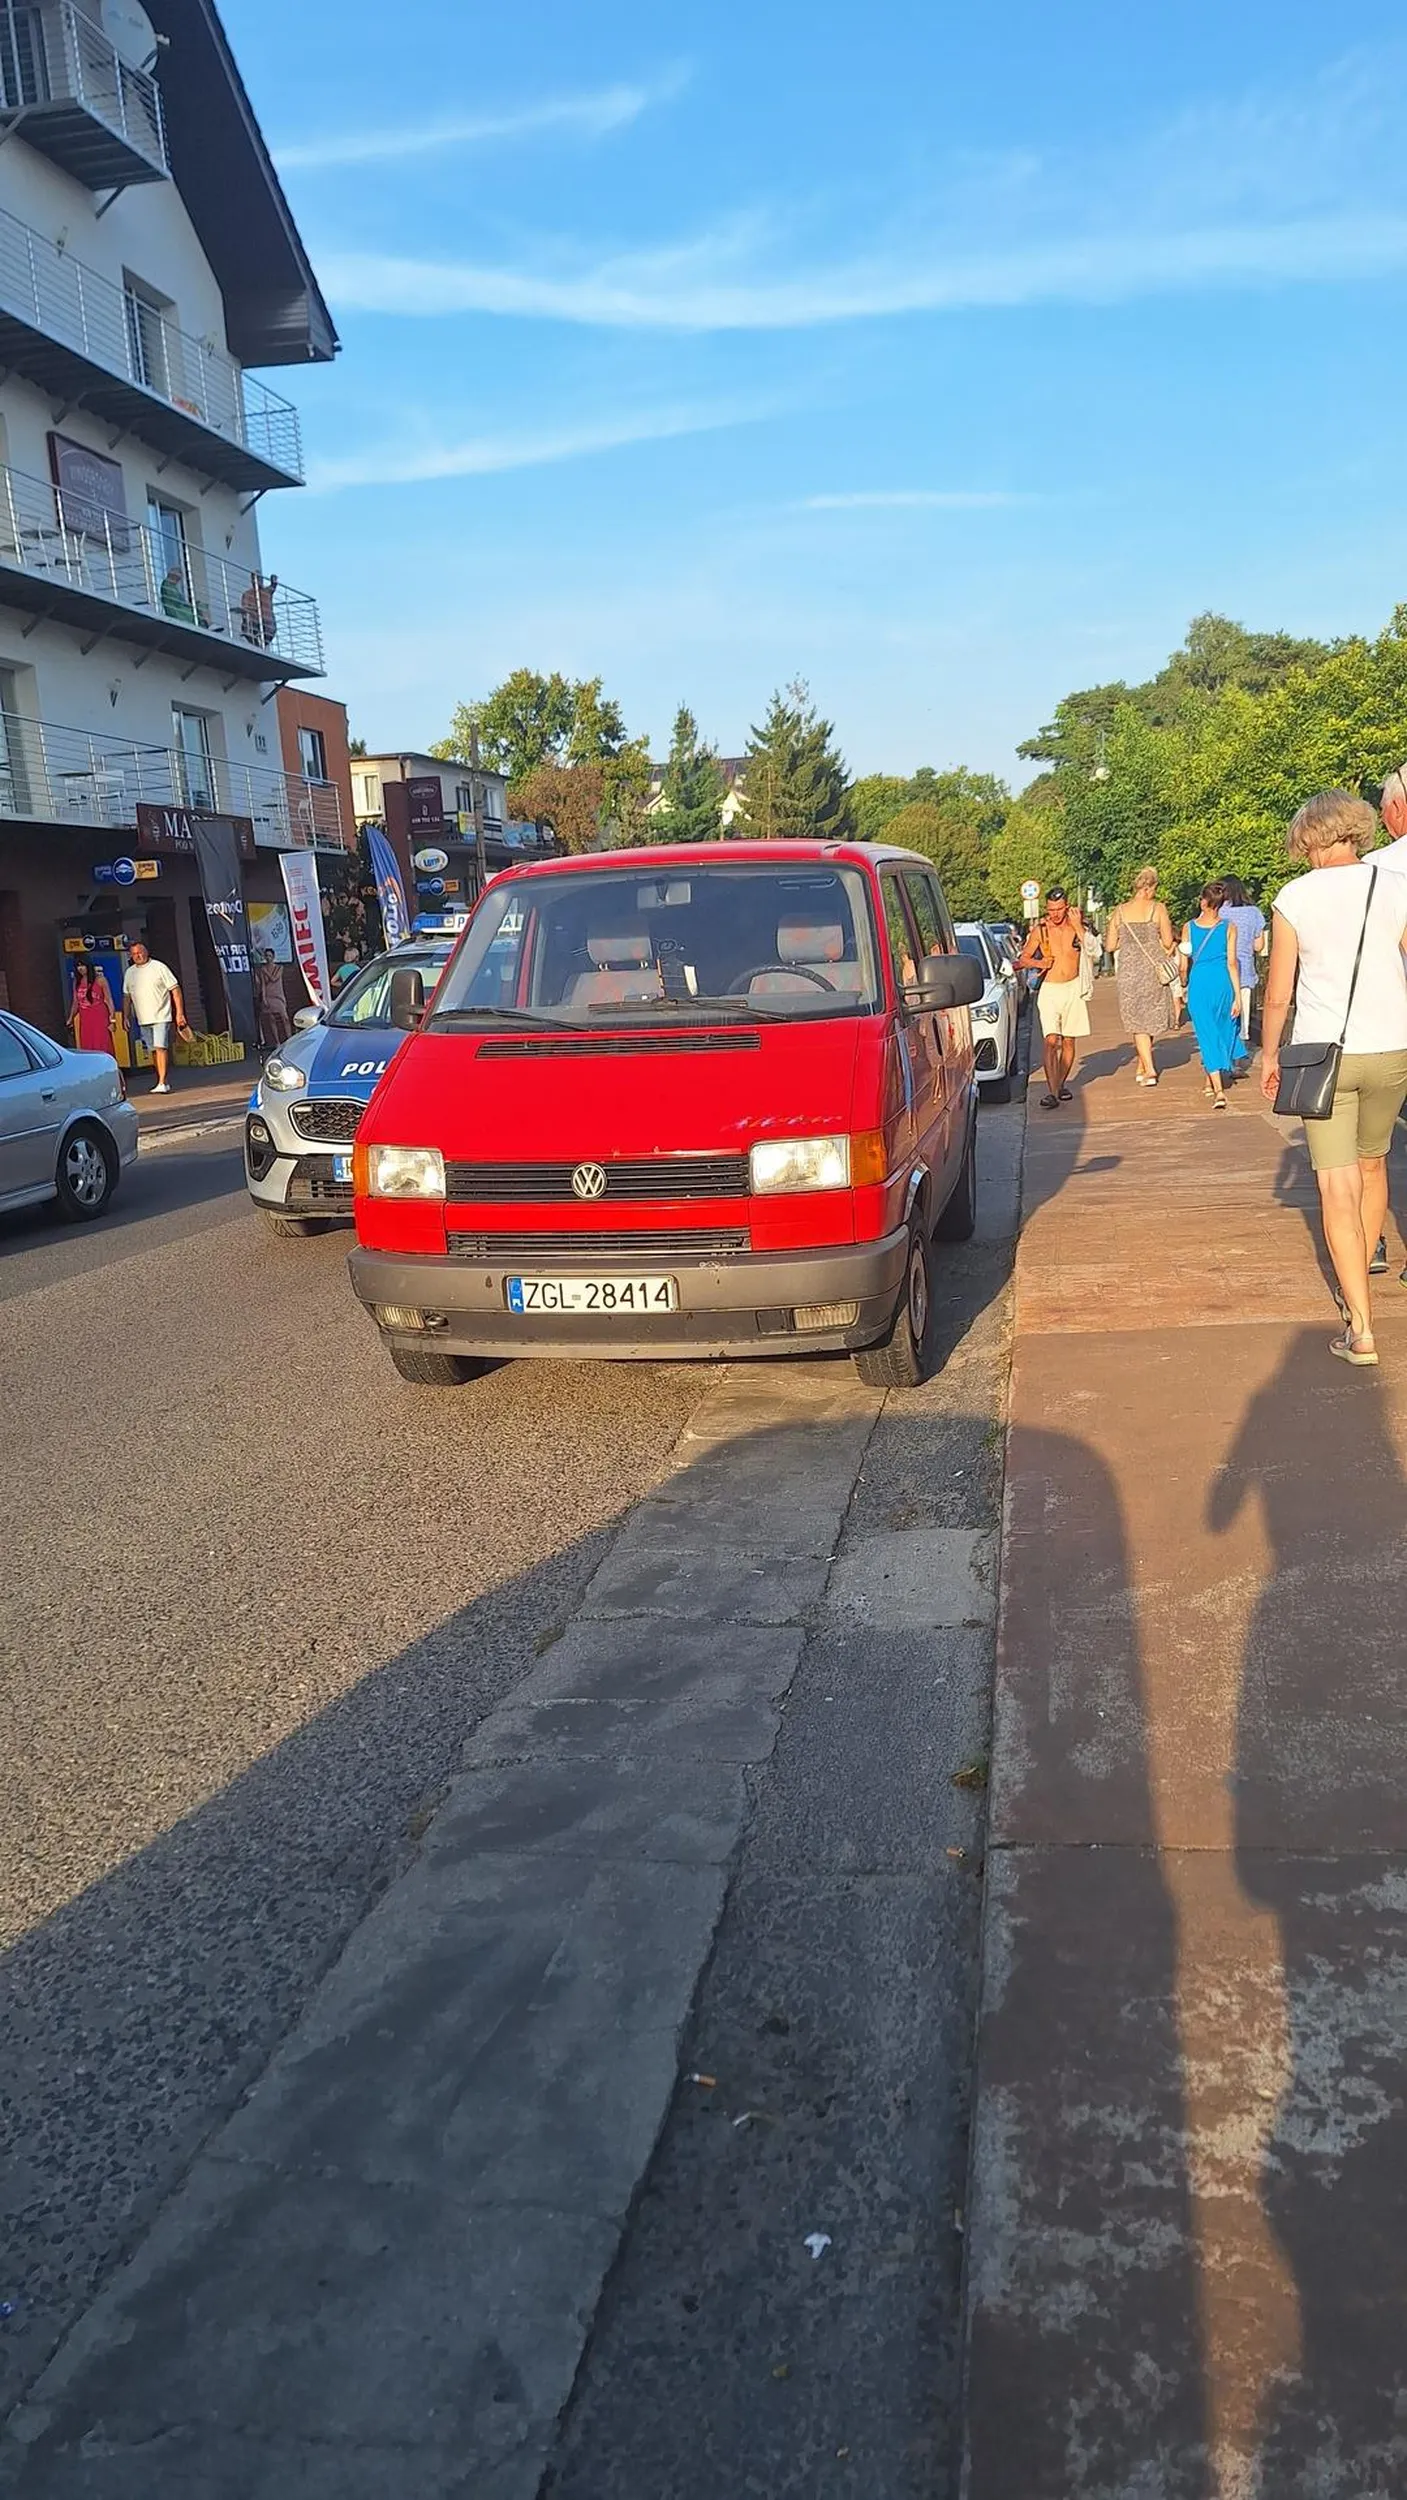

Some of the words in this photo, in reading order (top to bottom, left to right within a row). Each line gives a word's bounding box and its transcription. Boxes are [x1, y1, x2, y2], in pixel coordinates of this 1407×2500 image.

[341, 1060, 387, 1077] POL
[524, 1282, 575, 1309] ZGL
[585, 1282, 670, 1309] 28414
